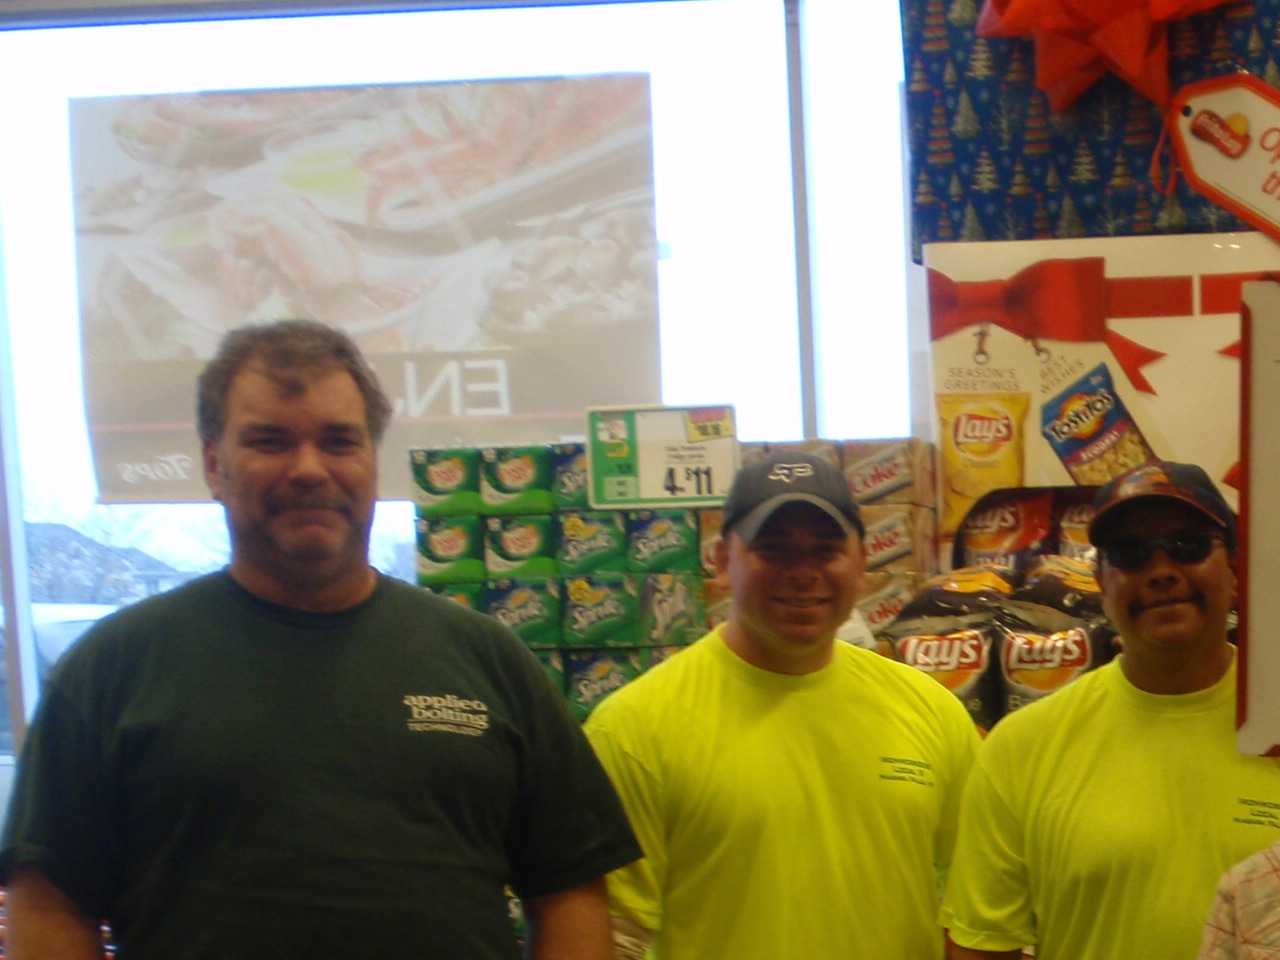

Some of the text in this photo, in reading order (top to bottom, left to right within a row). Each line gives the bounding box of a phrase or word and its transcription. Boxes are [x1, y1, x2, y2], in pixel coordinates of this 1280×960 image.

[949, 367, 1016, 378] SEASON'S
[1039, 355, 1068, 380] BEST
[944, 380, 1021, 391] GREETINGS
[953, 413, 1012, 445] Lay's
[1044, 388, 1116, 443] Tostitos
[864, 530, 901, 560] oke
[866, 597, 905, 626] oke
[905, 632, 984, 670] Lay's
[1009, 628, 1087, 669] Lay's
[403, 694, 488, 712] applied
[411, 707, 489, 730] bolting
